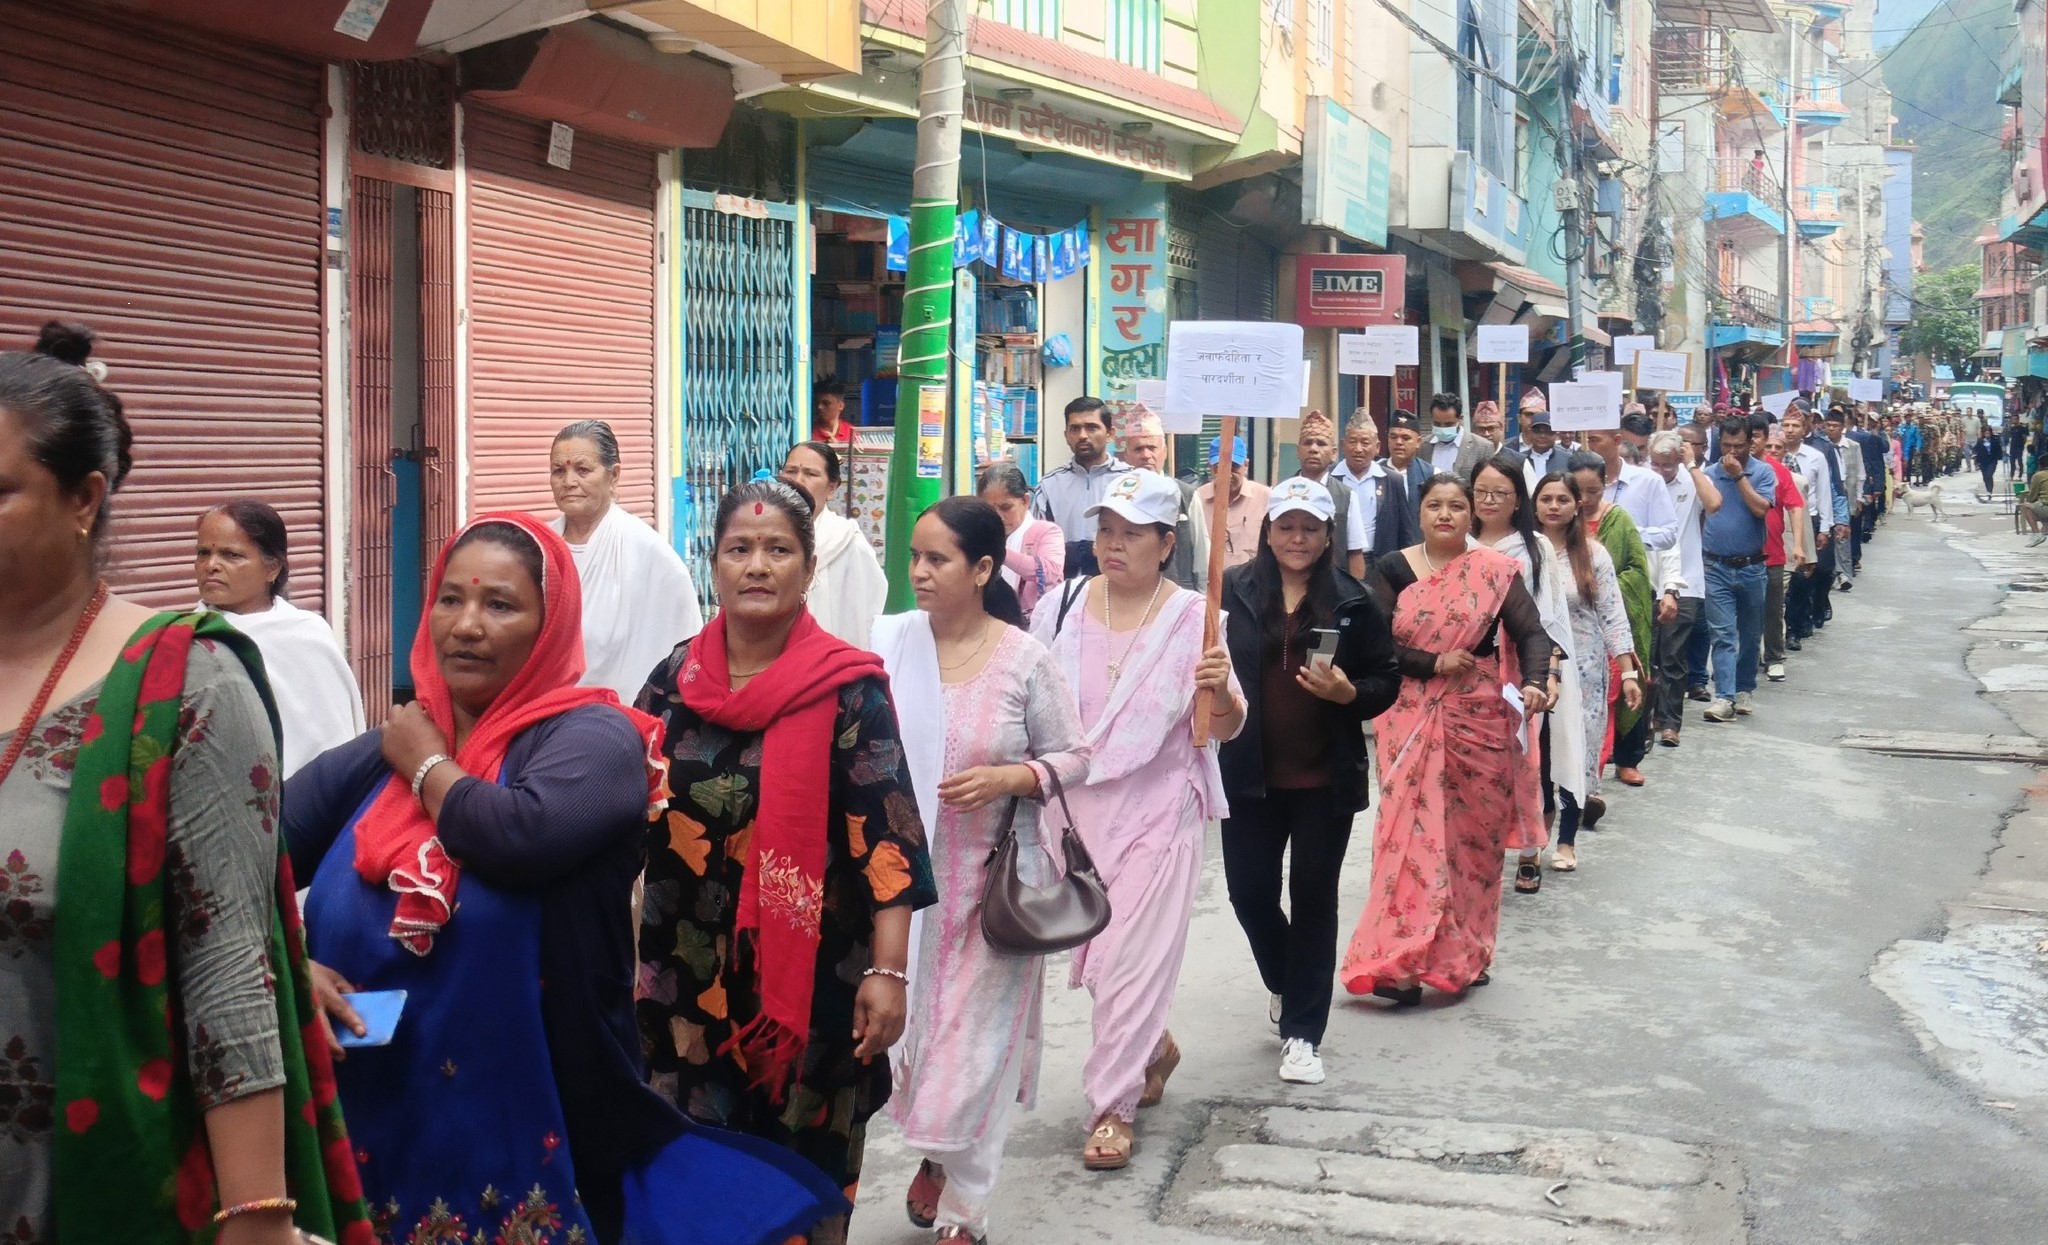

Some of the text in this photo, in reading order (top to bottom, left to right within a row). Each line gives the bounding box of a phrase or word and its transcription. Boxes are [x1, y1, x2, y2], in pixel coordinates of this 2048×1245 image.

[1018, 102, 1111, 155] स्टेशनरी
[1323, 275, 1378, 293] IME
[1196, 350, 1263, 363] जवाफदेहिता र
